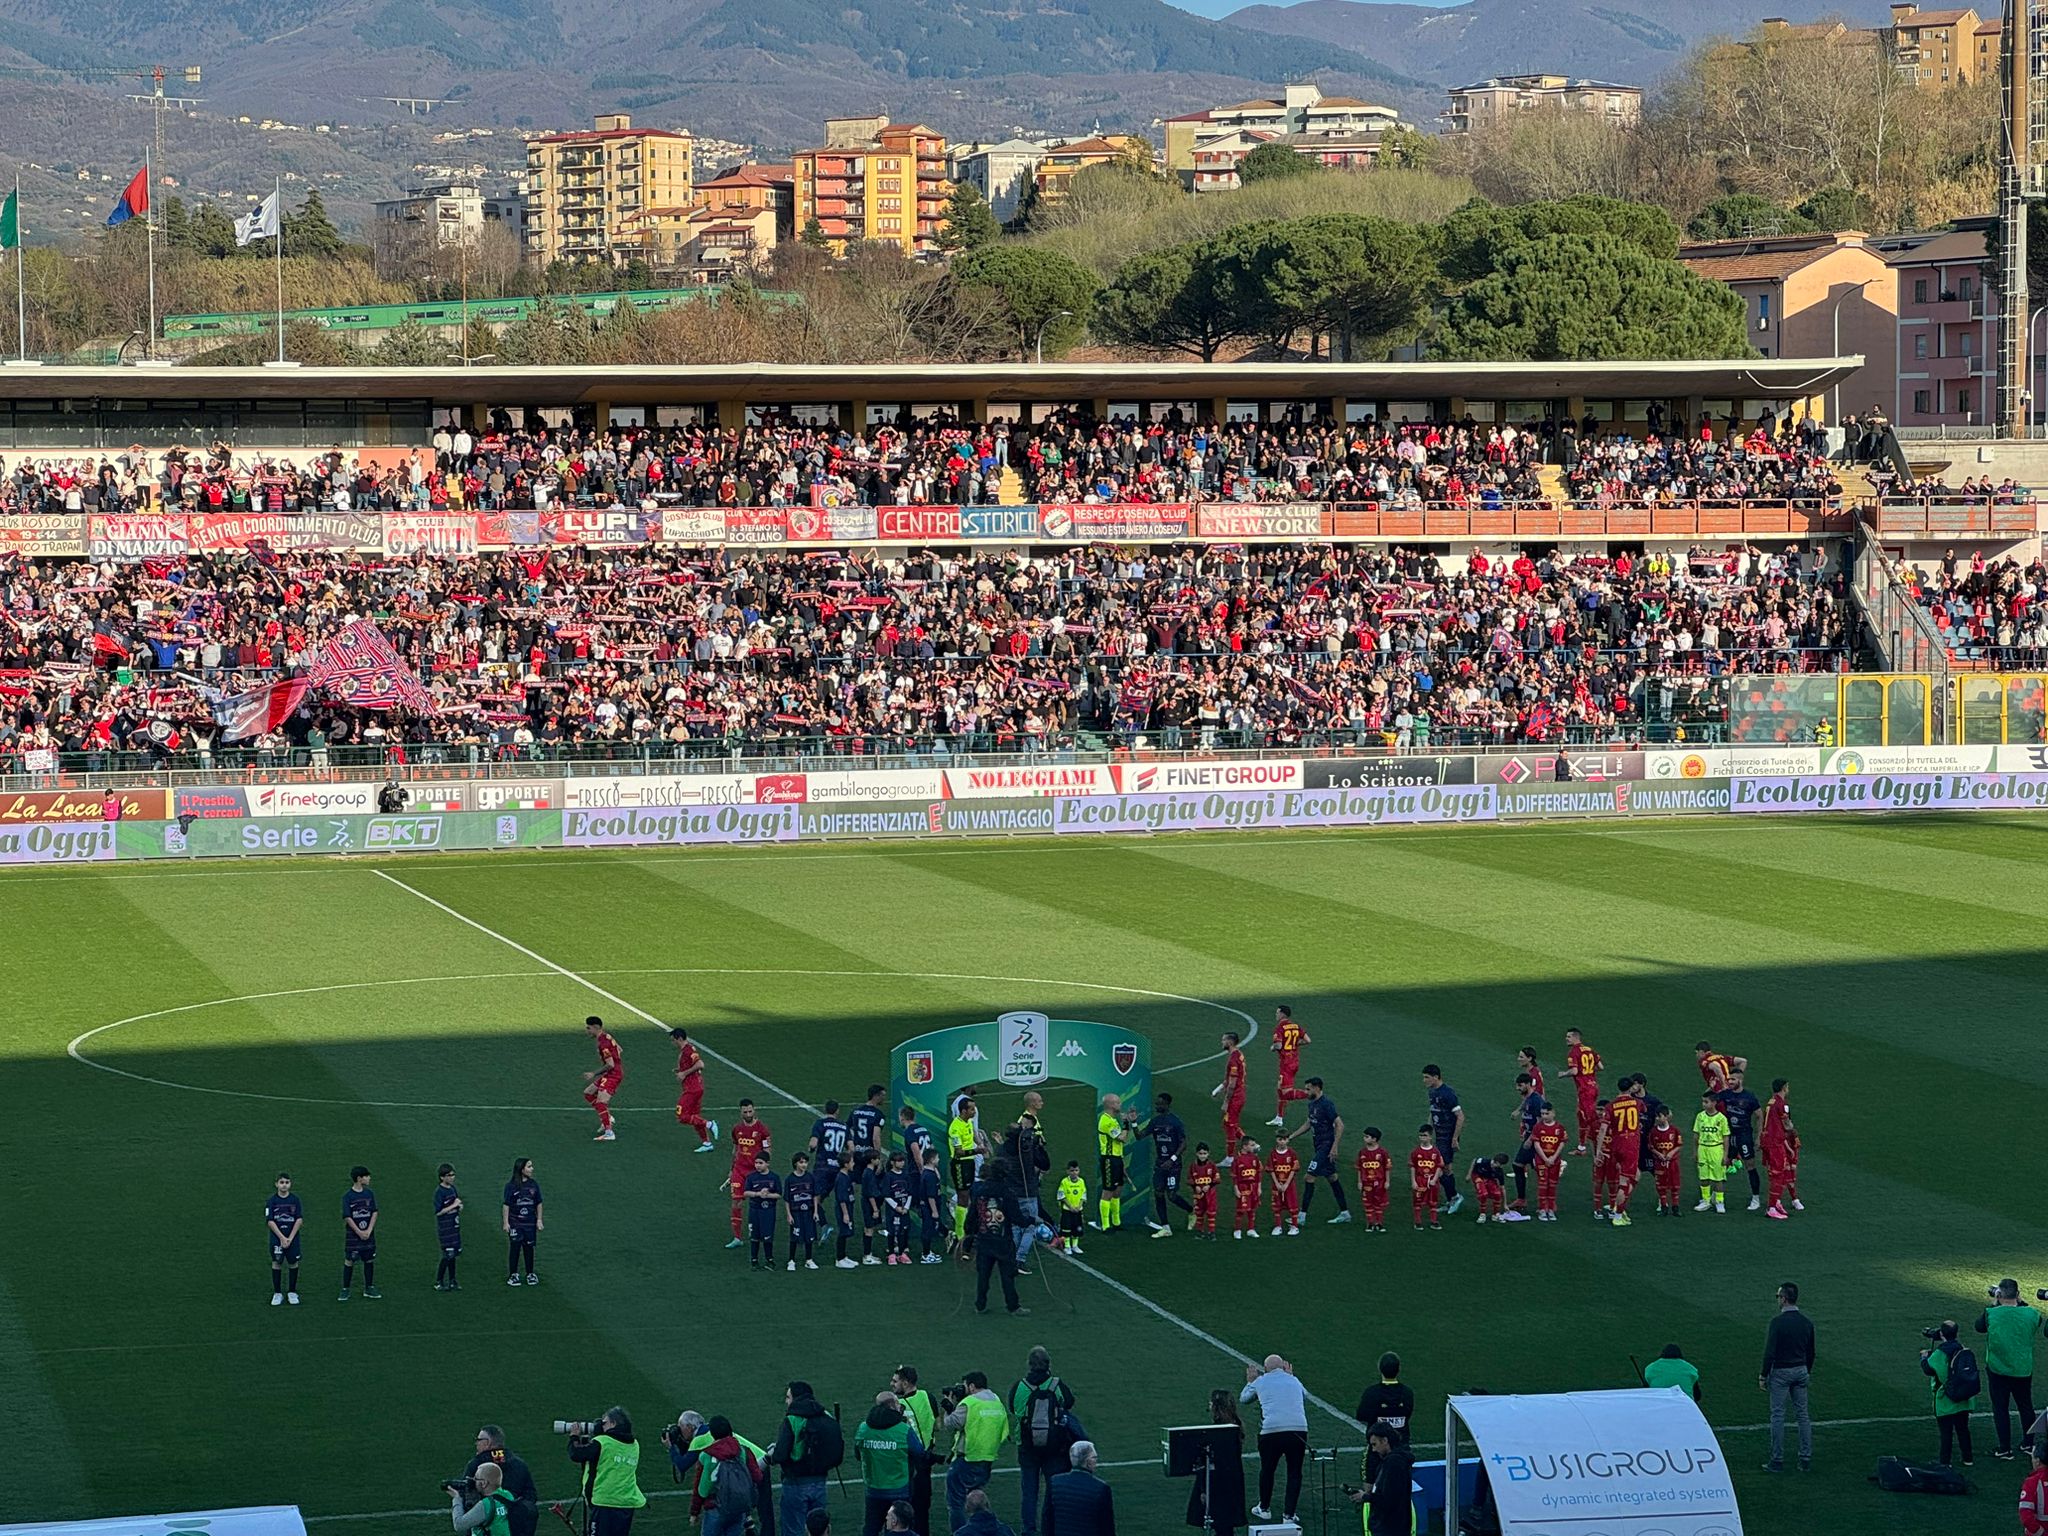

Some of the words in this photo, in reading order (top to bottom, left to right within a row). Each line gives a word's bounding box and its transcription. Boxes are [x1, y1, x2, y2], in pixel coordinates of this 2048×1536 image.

[664, 512, 701, 522] COSENZA
[703, 512, 723, 523] CLUB
[1074, 509, 1117, 519] RESPECT
[1118, 508, 1160, 519] COSENZA
[1162, 508, 1187, 518] CLUB
[1223, 506, 1283, 517] COSENZA
[1285, 506, 1317, 517] CLUB
[21, 517, 61, 528] ROSSO
[64, 517, 79, 527] BLU
[416, 518, 445, 527] CLUB
[564, 513, 638, 531] LUPI
[883, 512, 962, 534] CENTRO
[969, 511, 1037, 534] STORICO
[1078, 525, 1107, 535] NESSUNO
[1113, 525, 1148, 535] STRANIERO
[1154, 525, 1182, 534] COSENZA
[1216, 518, 1261, 534] NEW
[1264, 518, 1319, 533] YORK
[107, 524, 170, 540] GIANNI
[191, 522, 240, 547] CENTRO
[244, 515, 346, 535] COORDINAMENTO
[348, 523, 381, 546] CLUB
[578, 531, 626, 541] CELICO
[664, 526, 725, 538] LUPACCHIOTTI
[730, 532, 782, 542] ROGLIANO
[94, 540, 112, 556] DI
[117, 540, 184, 556] MARZIO
[1167, 766, 1296, 785] FINETGROUP
[1535, 757, 1617, 778] PXEL
[1714, 767, 1735, 775] Fichi
[1737, 767, 1745, 775] di
[1746, 767, 1786, 775] Cosenza
[968, 769, 1097, 788] NOLEGGIAMI
[1328, 775, 1351, 788] Lo
[1360, 773, 1433, 788] Sciatore
[416, 788, 461, 800] PORTE
[506, 786, 549, 799] PORTE
[811, 781, 936, 800] gambilongogroup.it
[1734, 777, 1867, 808] Ecologia
[1872, 776, 1943, 806] Oggi
[2, 796, 38, 818] La
[42, 794, 140, 817] Locaa
[192, 795, 235, 806] Prestito
[281, 792, 367, 809] finetgroup
[1281, 790, 1416, 821] Ecologia
[1421, 786, 1491, 818] Oggi
[1497, 796, 1514, 813] LA
[1515, 792, 1615, 812] DIFFERENZIATA
[1633, 791, 1651, 809] UN
[1654, 788, 1729, 808] VANTAGGIO
[203, 806, 243, 818] cercavi
[1058, 795, 1198, 828] Ecologia
[1202, 793, 1275, 825] Oggi
[565, 808, 712, 841] Ecologia
[716, 804, 792, 839] Oggi
[799, 814, 818, 833] LA
[820, 811, 927, 833] DIFFERENZIATA
[948, 810, 971, 830] UN
[971, 808, 1053, 829] VANTAGGIO
[27, 824, 112, 859] Oggi
[242, 824, 318, 849] Serie
[368, 823, 438, 841] BKT
[1284, 1030, 1299, 1050] 27
[1013, 1052, 1034, 1060] Serie
[1581, 1053, 1595, 1075] 92
[1005, 1062, 1042, 1076] BKT
[1614, 1107, 1638, 1132] 70
[857, 1118, 868, 1139] 5
[738, 1138, 755, 1146] coop
[824, 1129, 846, 1153] 30
[1541, 1136, 1558, 1144] coop
[1363, 1161, 1380, 1169] coop
[1418, 1160, 1435, 1168] coop
[1167, 1177, 1175, 1186] 18
[1195, 1177, 1211, 1185] coop
[863, 1440, 897, 1450] FOTOGRAFO
[1542, 1492, 1601, 1508] dynamic
[1604, 1488, 1675, 1506] integrated
[1679, 1488, 1729, 1502] system
